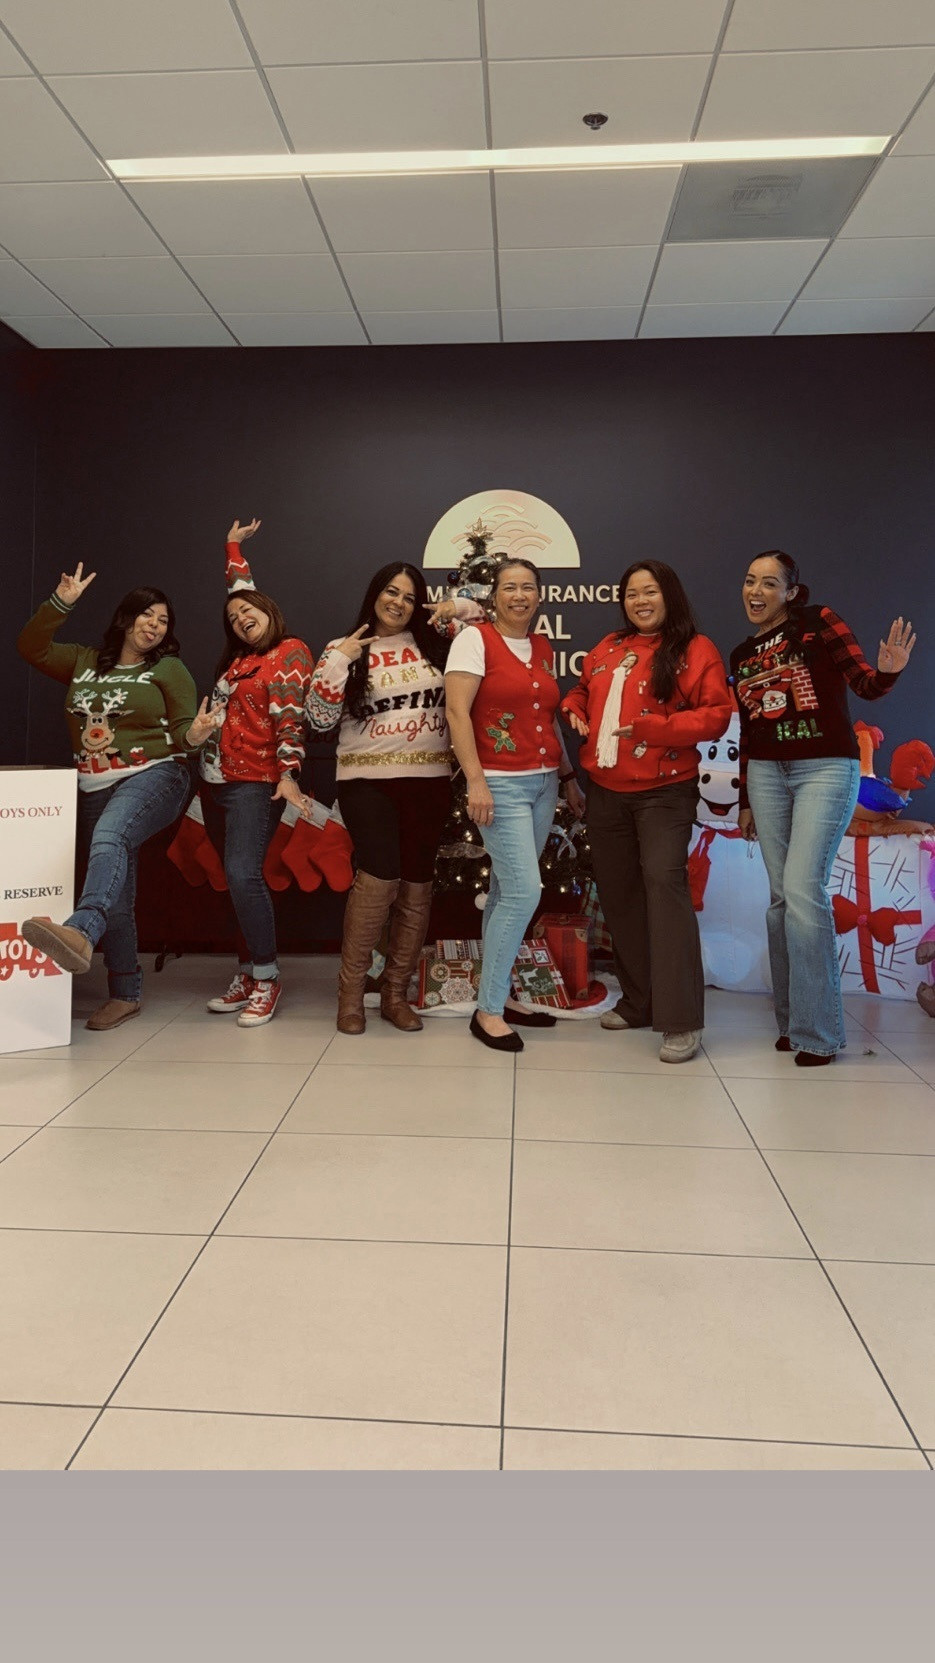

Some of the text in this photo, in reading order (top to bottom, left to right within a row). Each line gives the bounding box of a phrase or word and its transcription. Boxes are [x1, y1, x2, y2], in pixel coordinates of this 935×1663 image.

[755, 632, 784, 654] THE
[368, 647, 425, 669] DEA
[73, 668, 155, 684] JINGLE
[360, 687, 446, 717] DEFIN
[76, 746, 150, 774] ELLS
[0, 805, 63, 819] OYS ONLY
[4, 886, 64, 900] RESERVE
